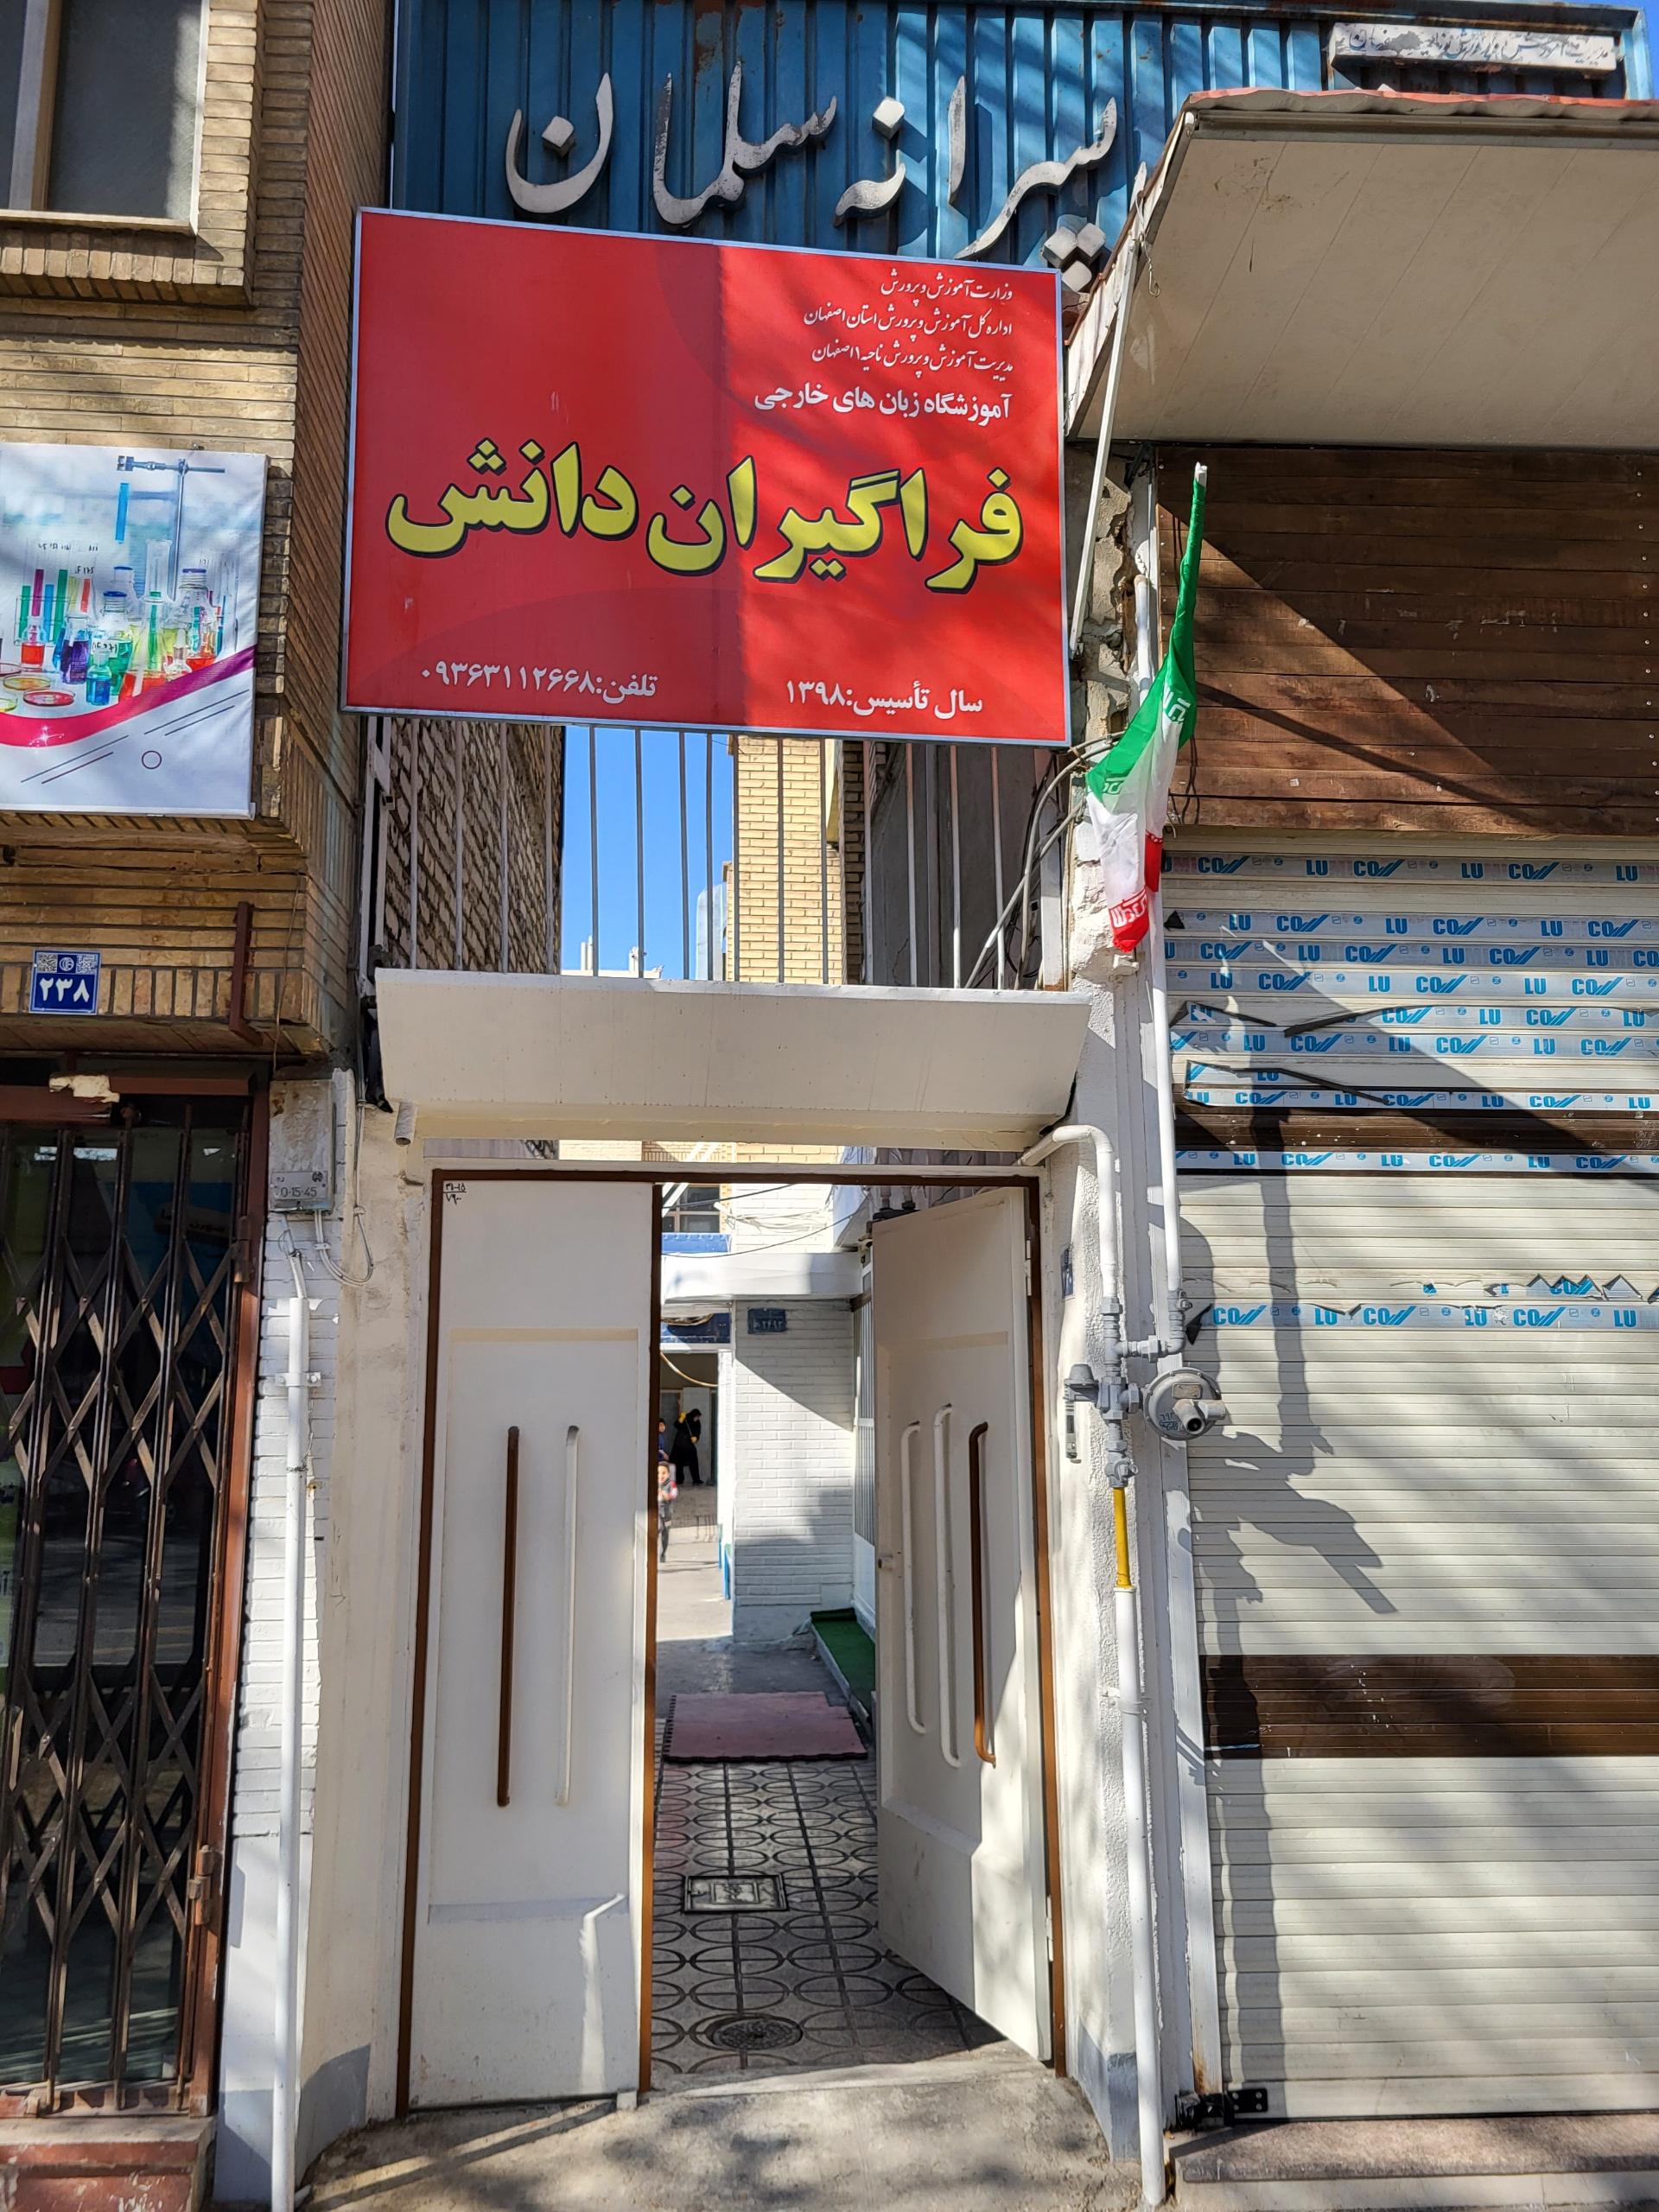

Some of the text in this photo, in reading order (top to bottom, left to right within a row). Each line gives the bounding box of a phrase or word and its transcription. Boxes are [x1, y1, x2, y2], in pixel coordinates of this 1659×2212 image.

[926, 272, 975, 300] آموزش
[969, 283, 1013, 301] وزارت
[804, 302, 846, 325] اصفهان
[846, 304, 877, 328] استان
[923, 307, 973, 335] آموزش
[968, 308, 992, 339] کل
[985, 320, 1013, 335] اداره
[929, 343, 978, 371] آموزش
[974, 357, 1014, 382] مدیریت
[753, 381, 1013, 427] آموزشگاه زبان های خارجی
[385, 437, 1025, 594] فراگیران دانش
[934, 689, 982, 720] سال
[39, 976, 91, 1003] ۲۳۸
